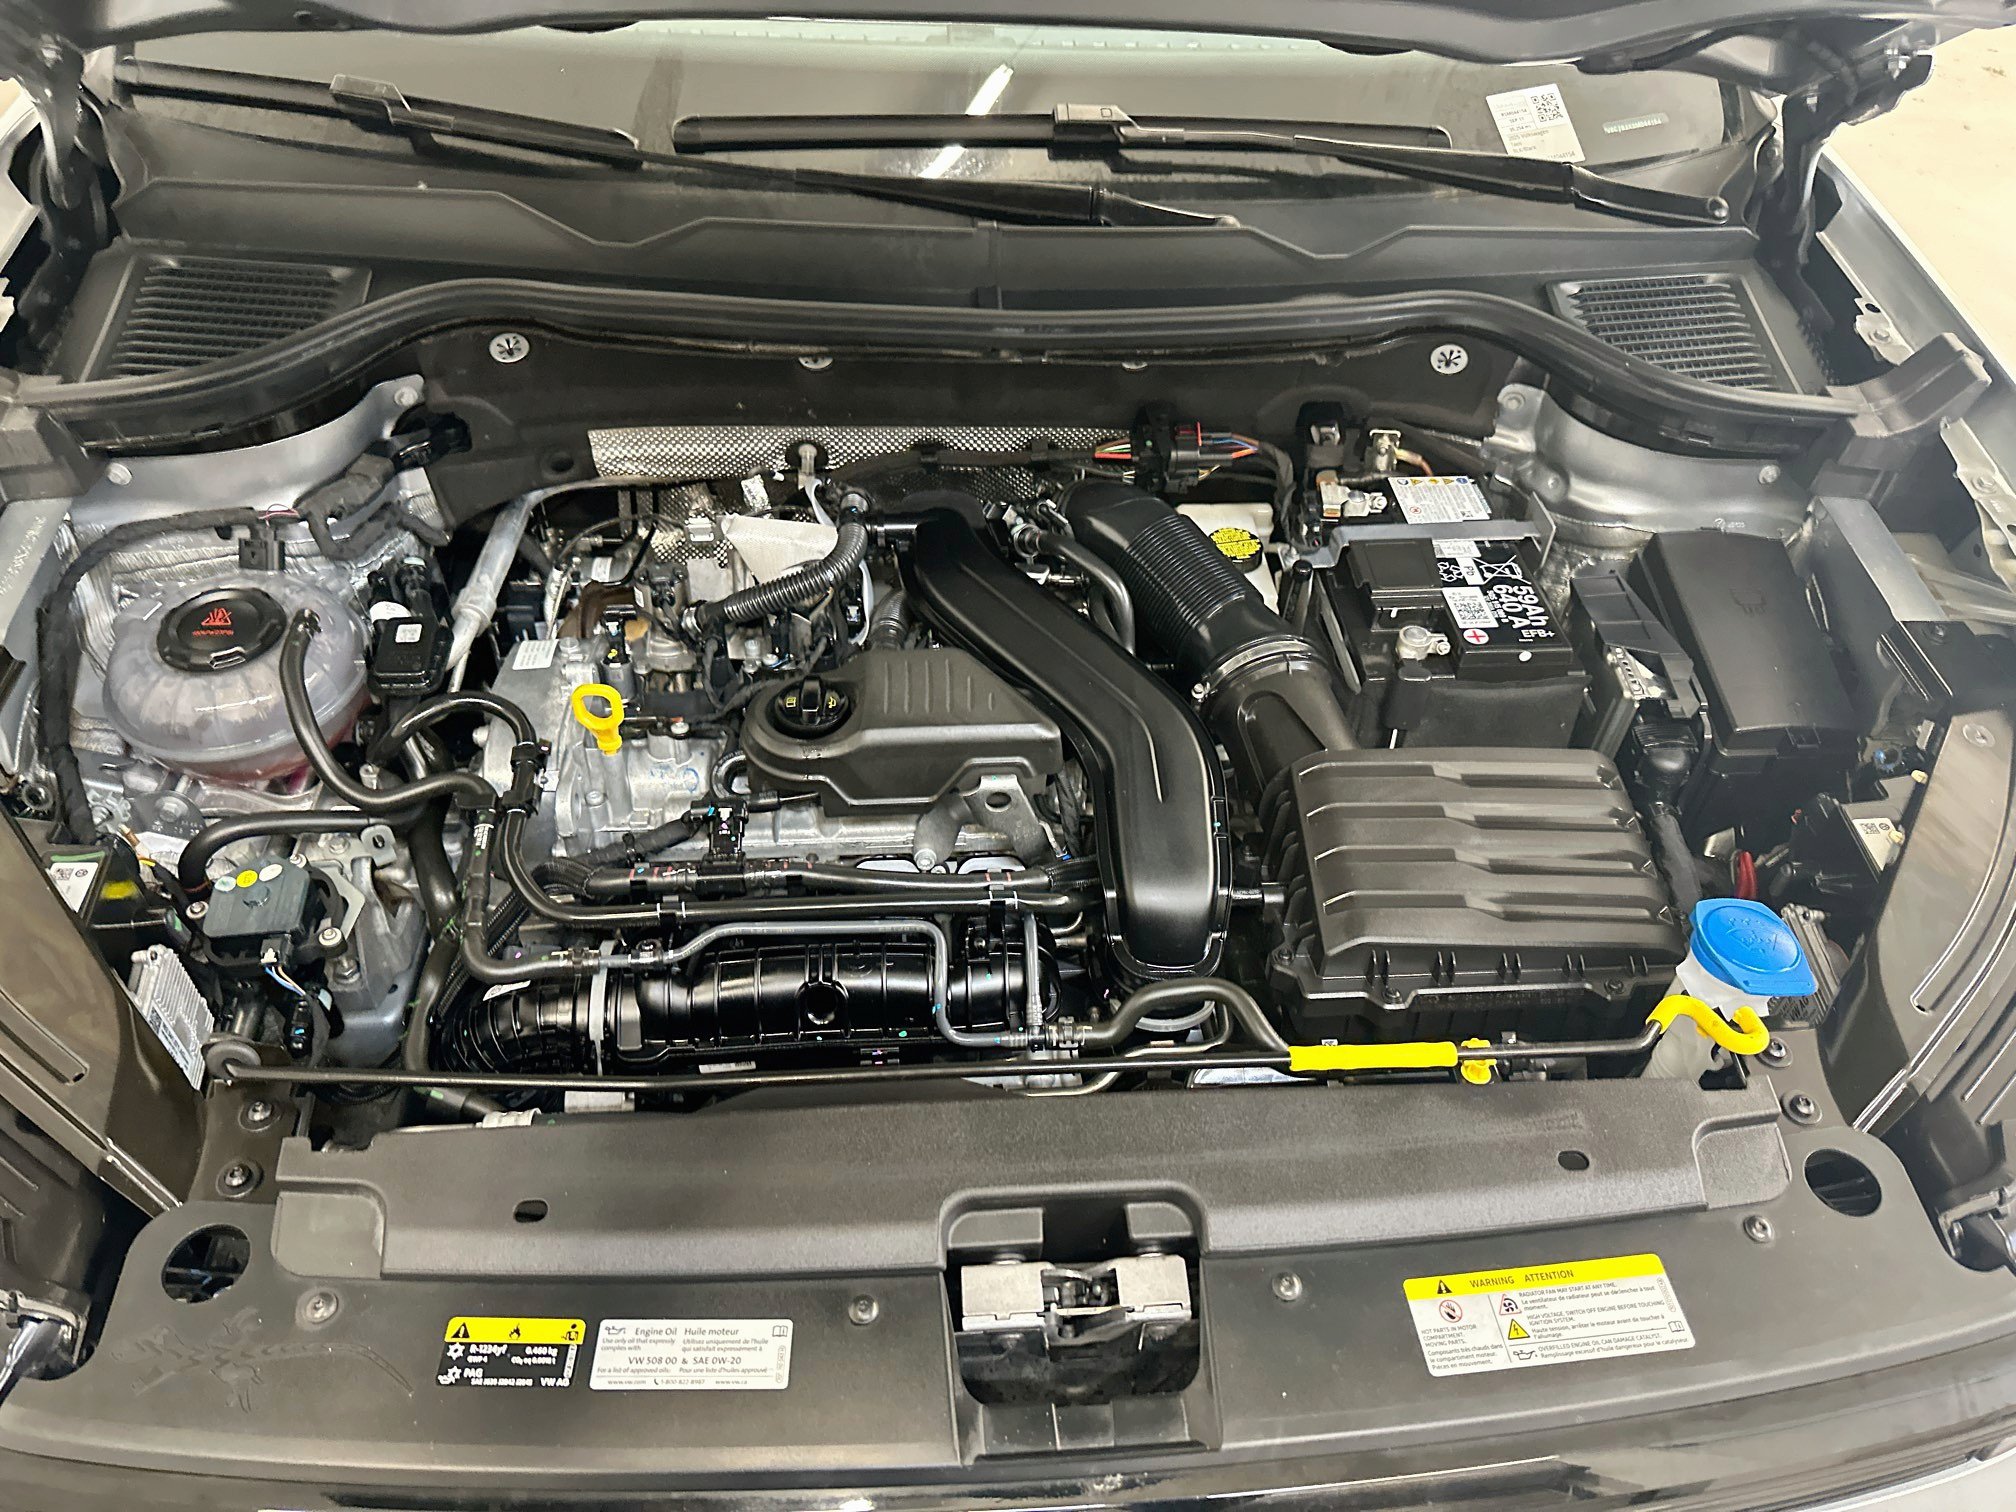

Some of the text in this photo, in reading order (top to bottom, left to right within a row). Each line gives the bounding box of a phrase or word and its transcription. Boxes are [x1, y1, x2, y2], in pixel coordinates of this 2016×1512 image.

[1492, 585, 1523, 613] 640
[1508, 615, 1531, 629] A
[1512, 585, 1550, 627] 59Ah
[1521, 629, 1555, 638] EFB+
[1469, 1269, 1574, 1288] WARNING ATTENTION
[1519, 1289, 1545, 1298] RADIATOR
[1638, 1300, 1665, 1308] TOUCHING
[635, 1327, 678, 1338] Engine Oil
[684, 1327, 740, 1336] Huile moteur
[705, 1338, 741, 1346] uniquement
[1538, 1343, 1570, 1352] OVERFILLED
[1613, 1335, 1635, 1343] DAMAGE
[628, 1356, 742, 1365] VW 508 00 & SAE 0W-20
[540, 1377, 556, 1387] VW
